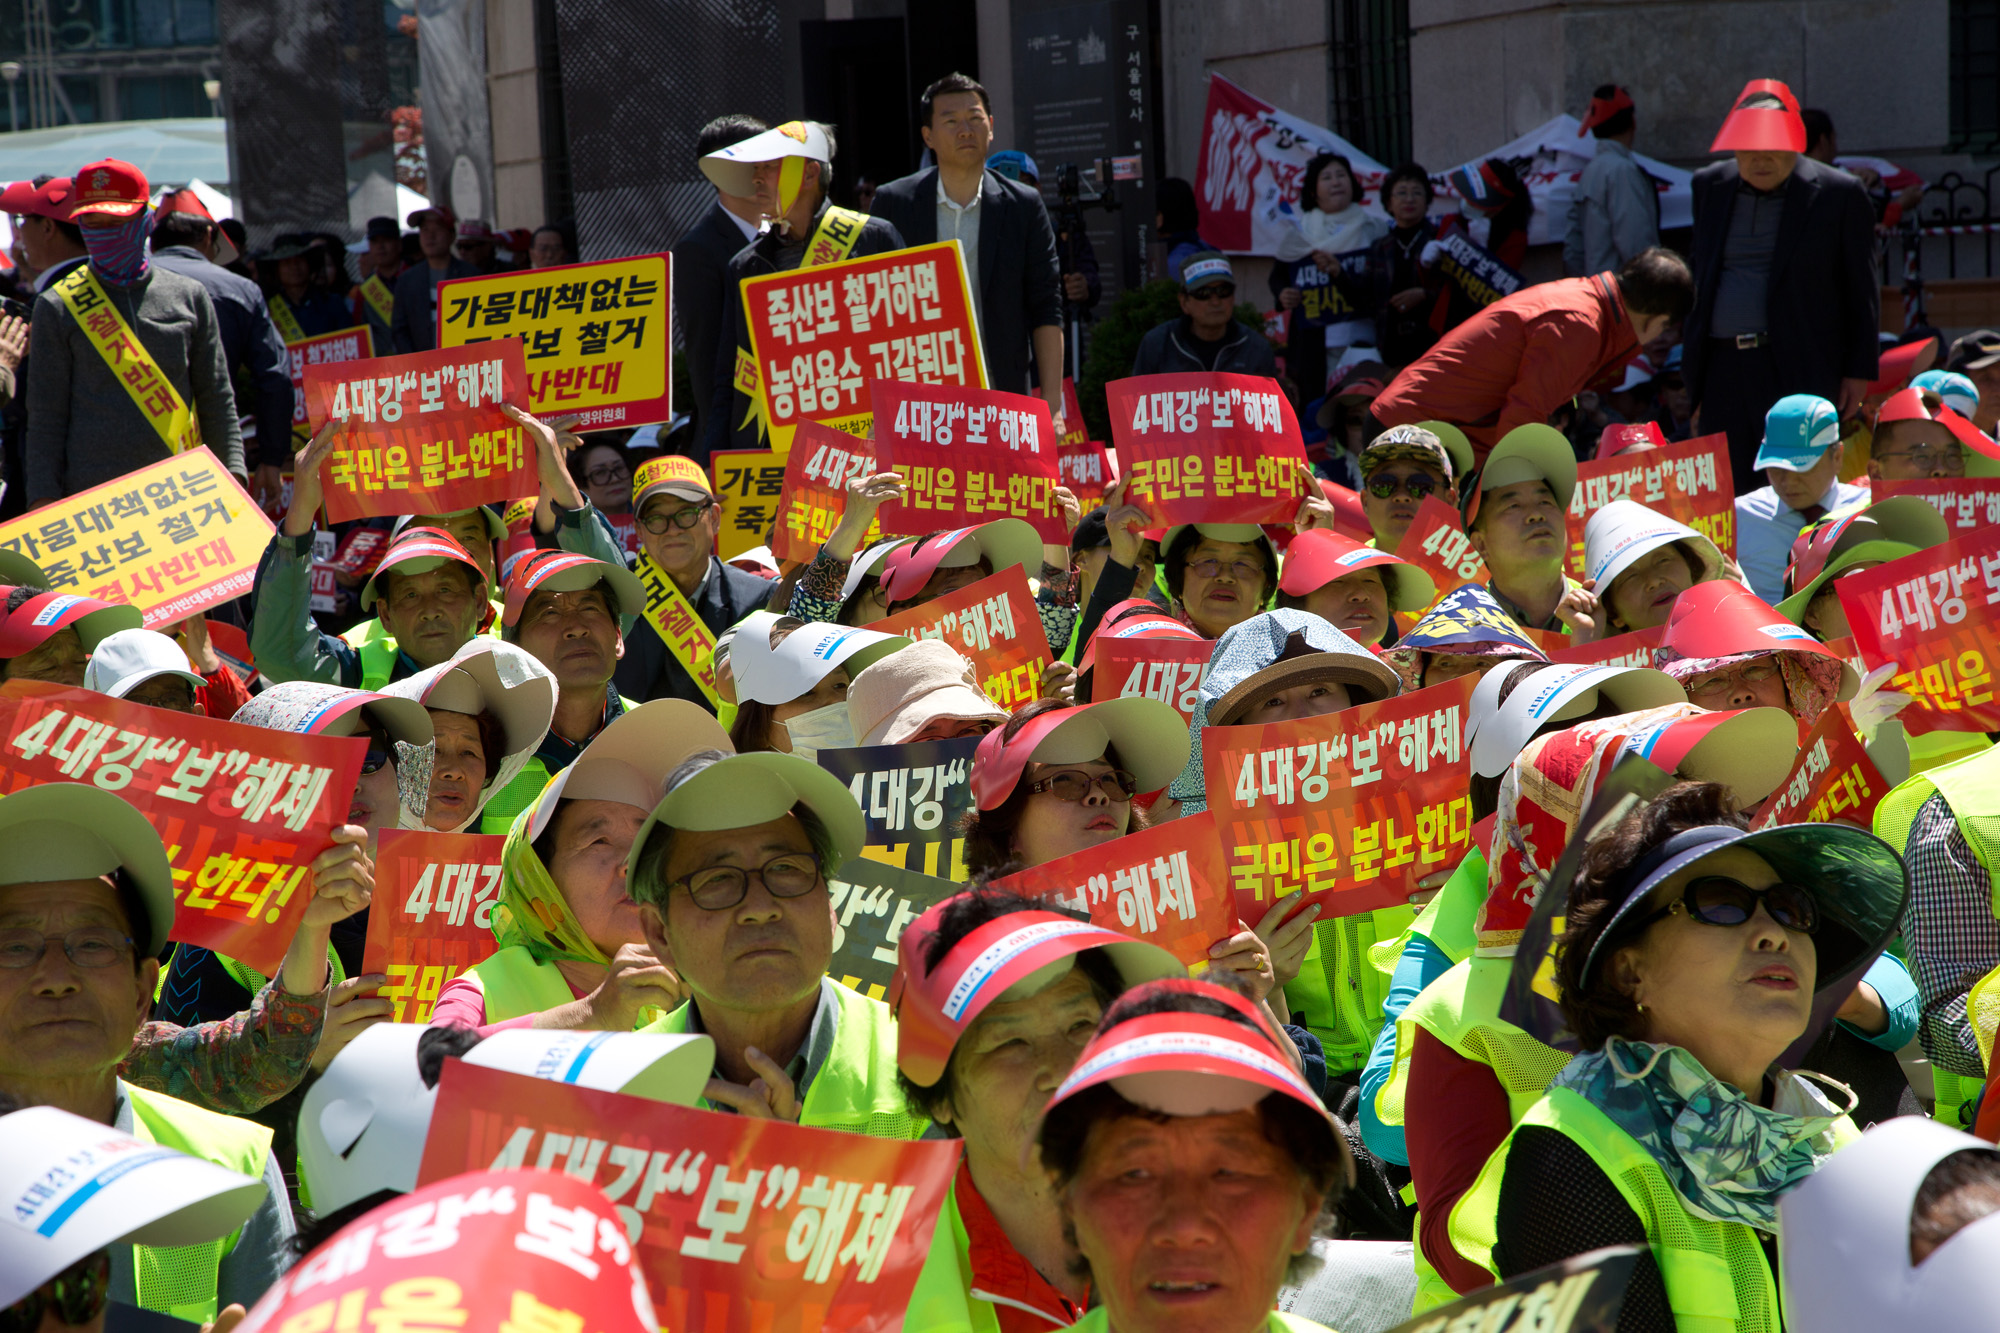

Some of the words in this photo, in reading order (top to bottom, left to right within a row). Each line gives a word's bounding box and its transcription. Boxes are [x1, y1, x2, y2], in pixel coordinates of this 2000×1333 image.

[1126, 25, 1140, 41] 구
[1127, 51, 1144, 122] 서울역사
[445, 274, 658, 329] 가뭄대책없는
[767, 280, 840, 346] 죽산보
[842, 260, 942, 334] 철거하면
[576, 316, 647, 357] 철거
[769, 346, 864, 419] 농업용수
[869, 327, 966, 386] 고갈된다
[331, 445, 411, 494] 국민은
[420, 426, 524, 488] 분노한다!
[891, 464, 957, 512] 국민은
[964, 470, 1059, 519] 분노한다!
[1130, 455, 1205, 503] 국민은
[1213, 454, 1305, 498] 분노한다!
[1, 469, 218, 561] 가뭄대책없는
[43, 531, 152, 590] 죽산보
[157, 497, 233, 545] 철거
[89, 536, 237, 606] 결사반대
[1231, 833, 1338, 902] 국민은
